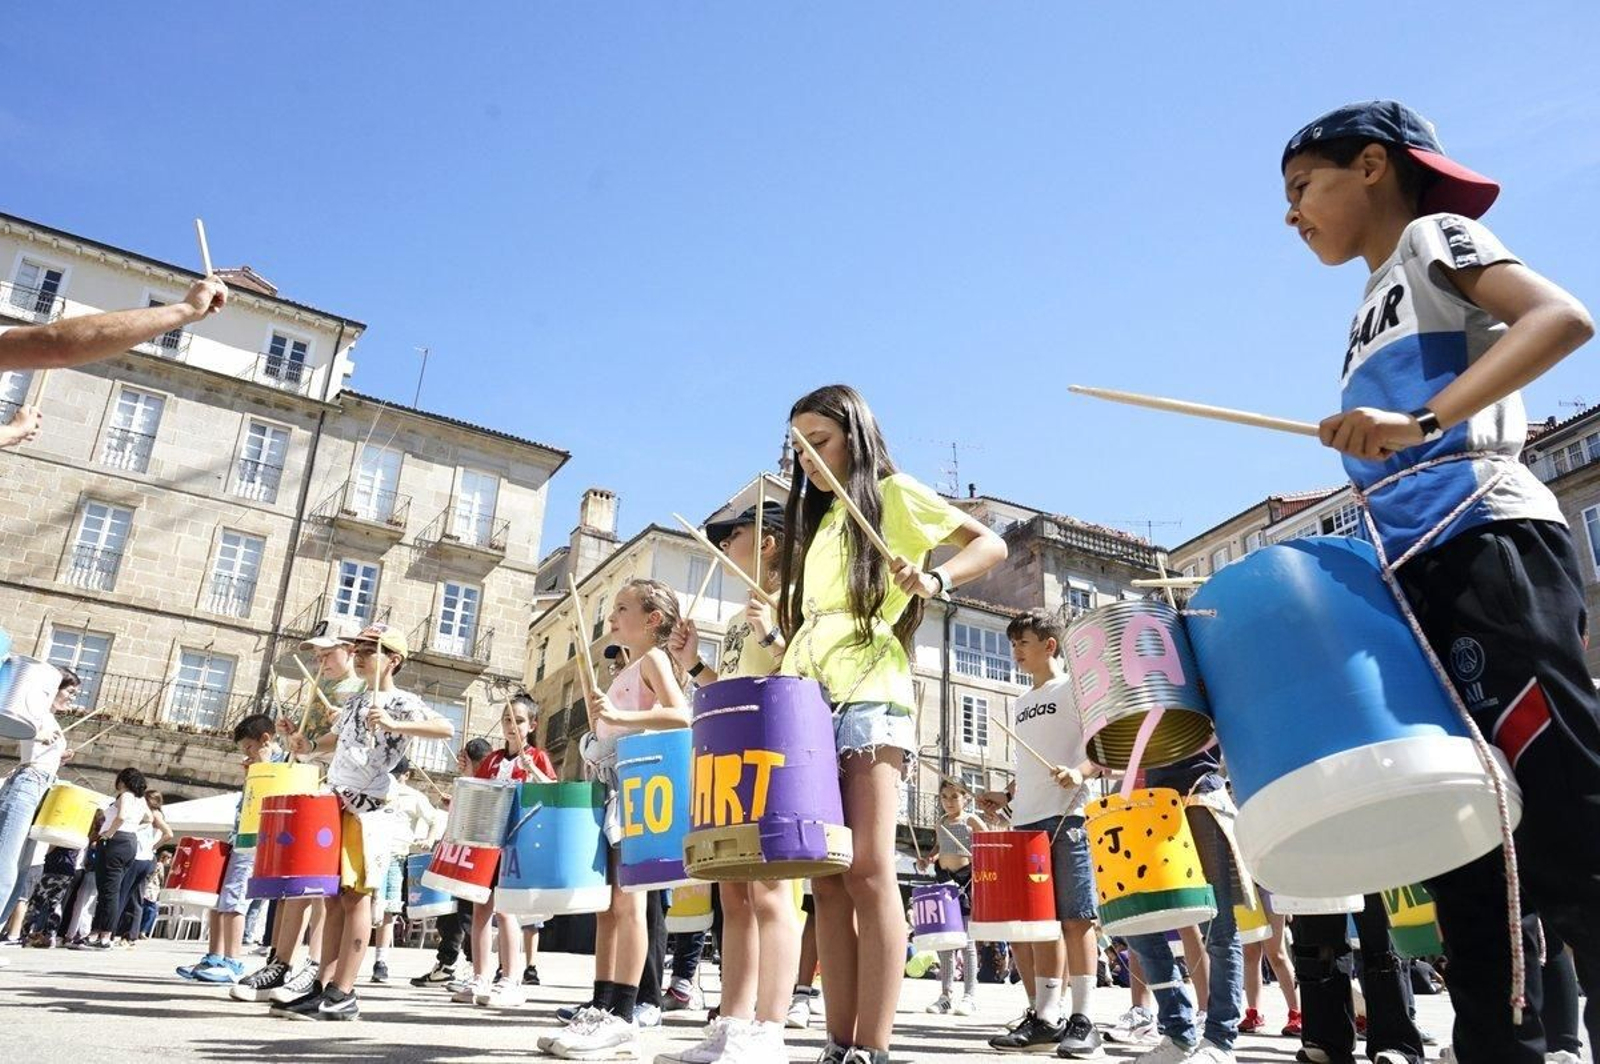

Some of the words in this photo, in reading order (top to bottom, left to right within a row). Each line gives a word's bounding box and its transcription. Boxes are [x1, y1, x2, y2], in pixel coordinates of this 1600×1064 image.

[1015, 702, 1057, 725] didas
[620, 775, 674, 837] EO
[691, 747, 786, 828] ART
